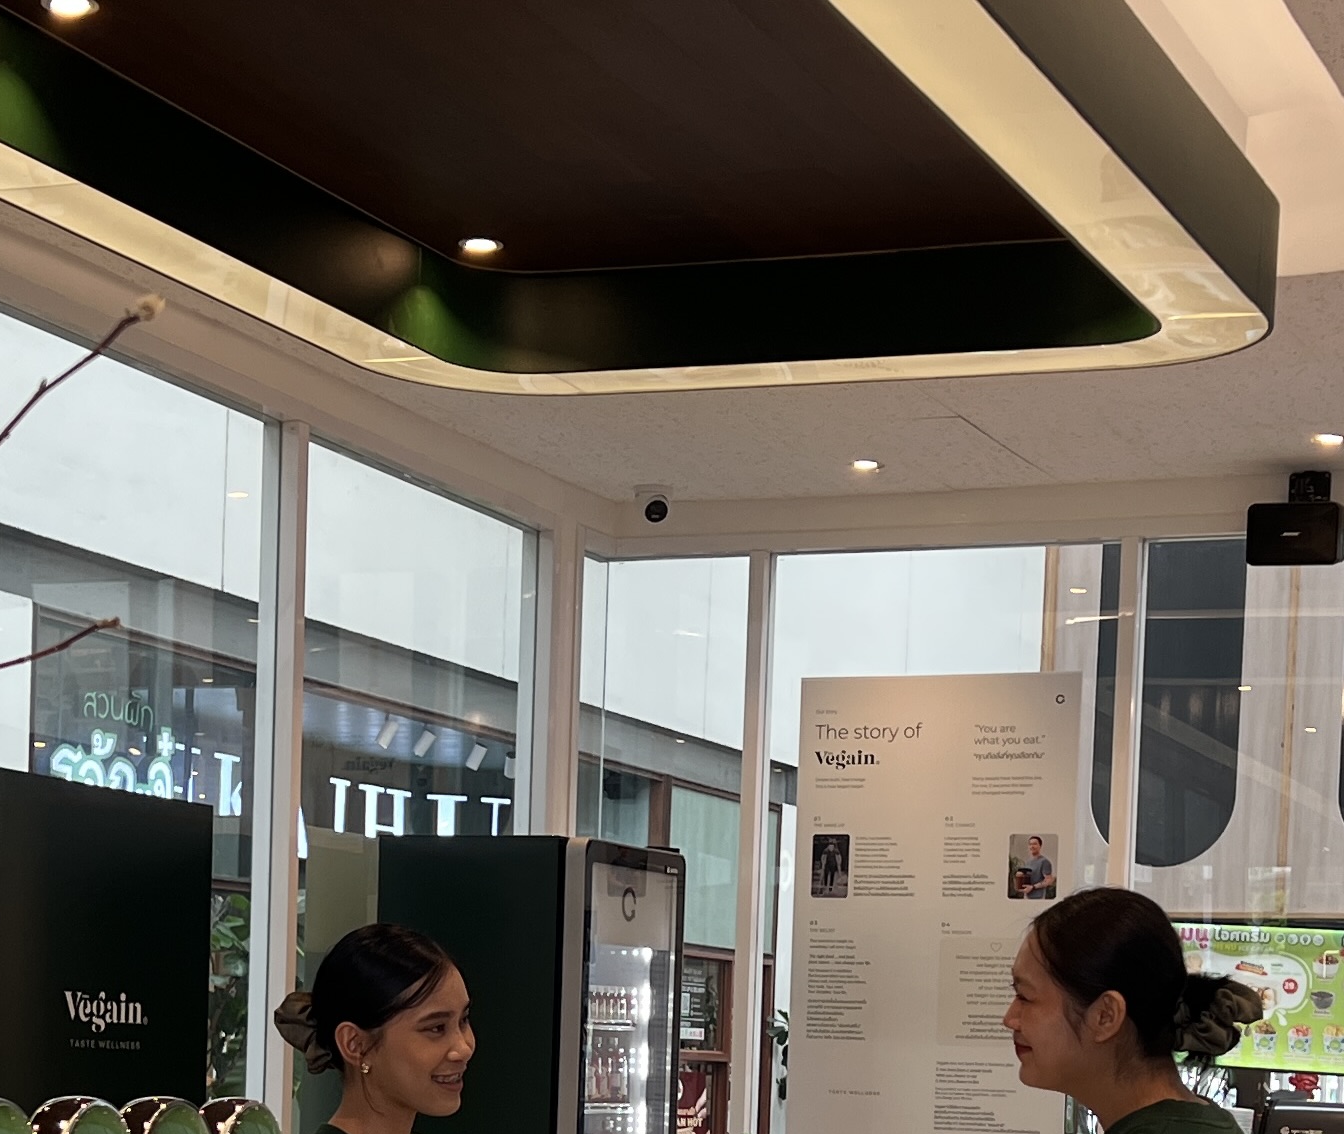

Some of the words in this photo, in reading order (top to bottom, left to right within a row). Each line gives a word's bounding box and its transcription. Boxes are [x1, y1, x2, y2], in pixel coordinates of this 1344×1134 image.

[815, 724, 849, 740] The
[854, 725, 900, 743] story
[904, 722, 923, 739] of
[974, 736, 999, 745] what
[1002, 737, 1020, 747] you
[69, 1039, 95, 1049] TASTE
[99, 1040, 141, 1050] WELLNESS
